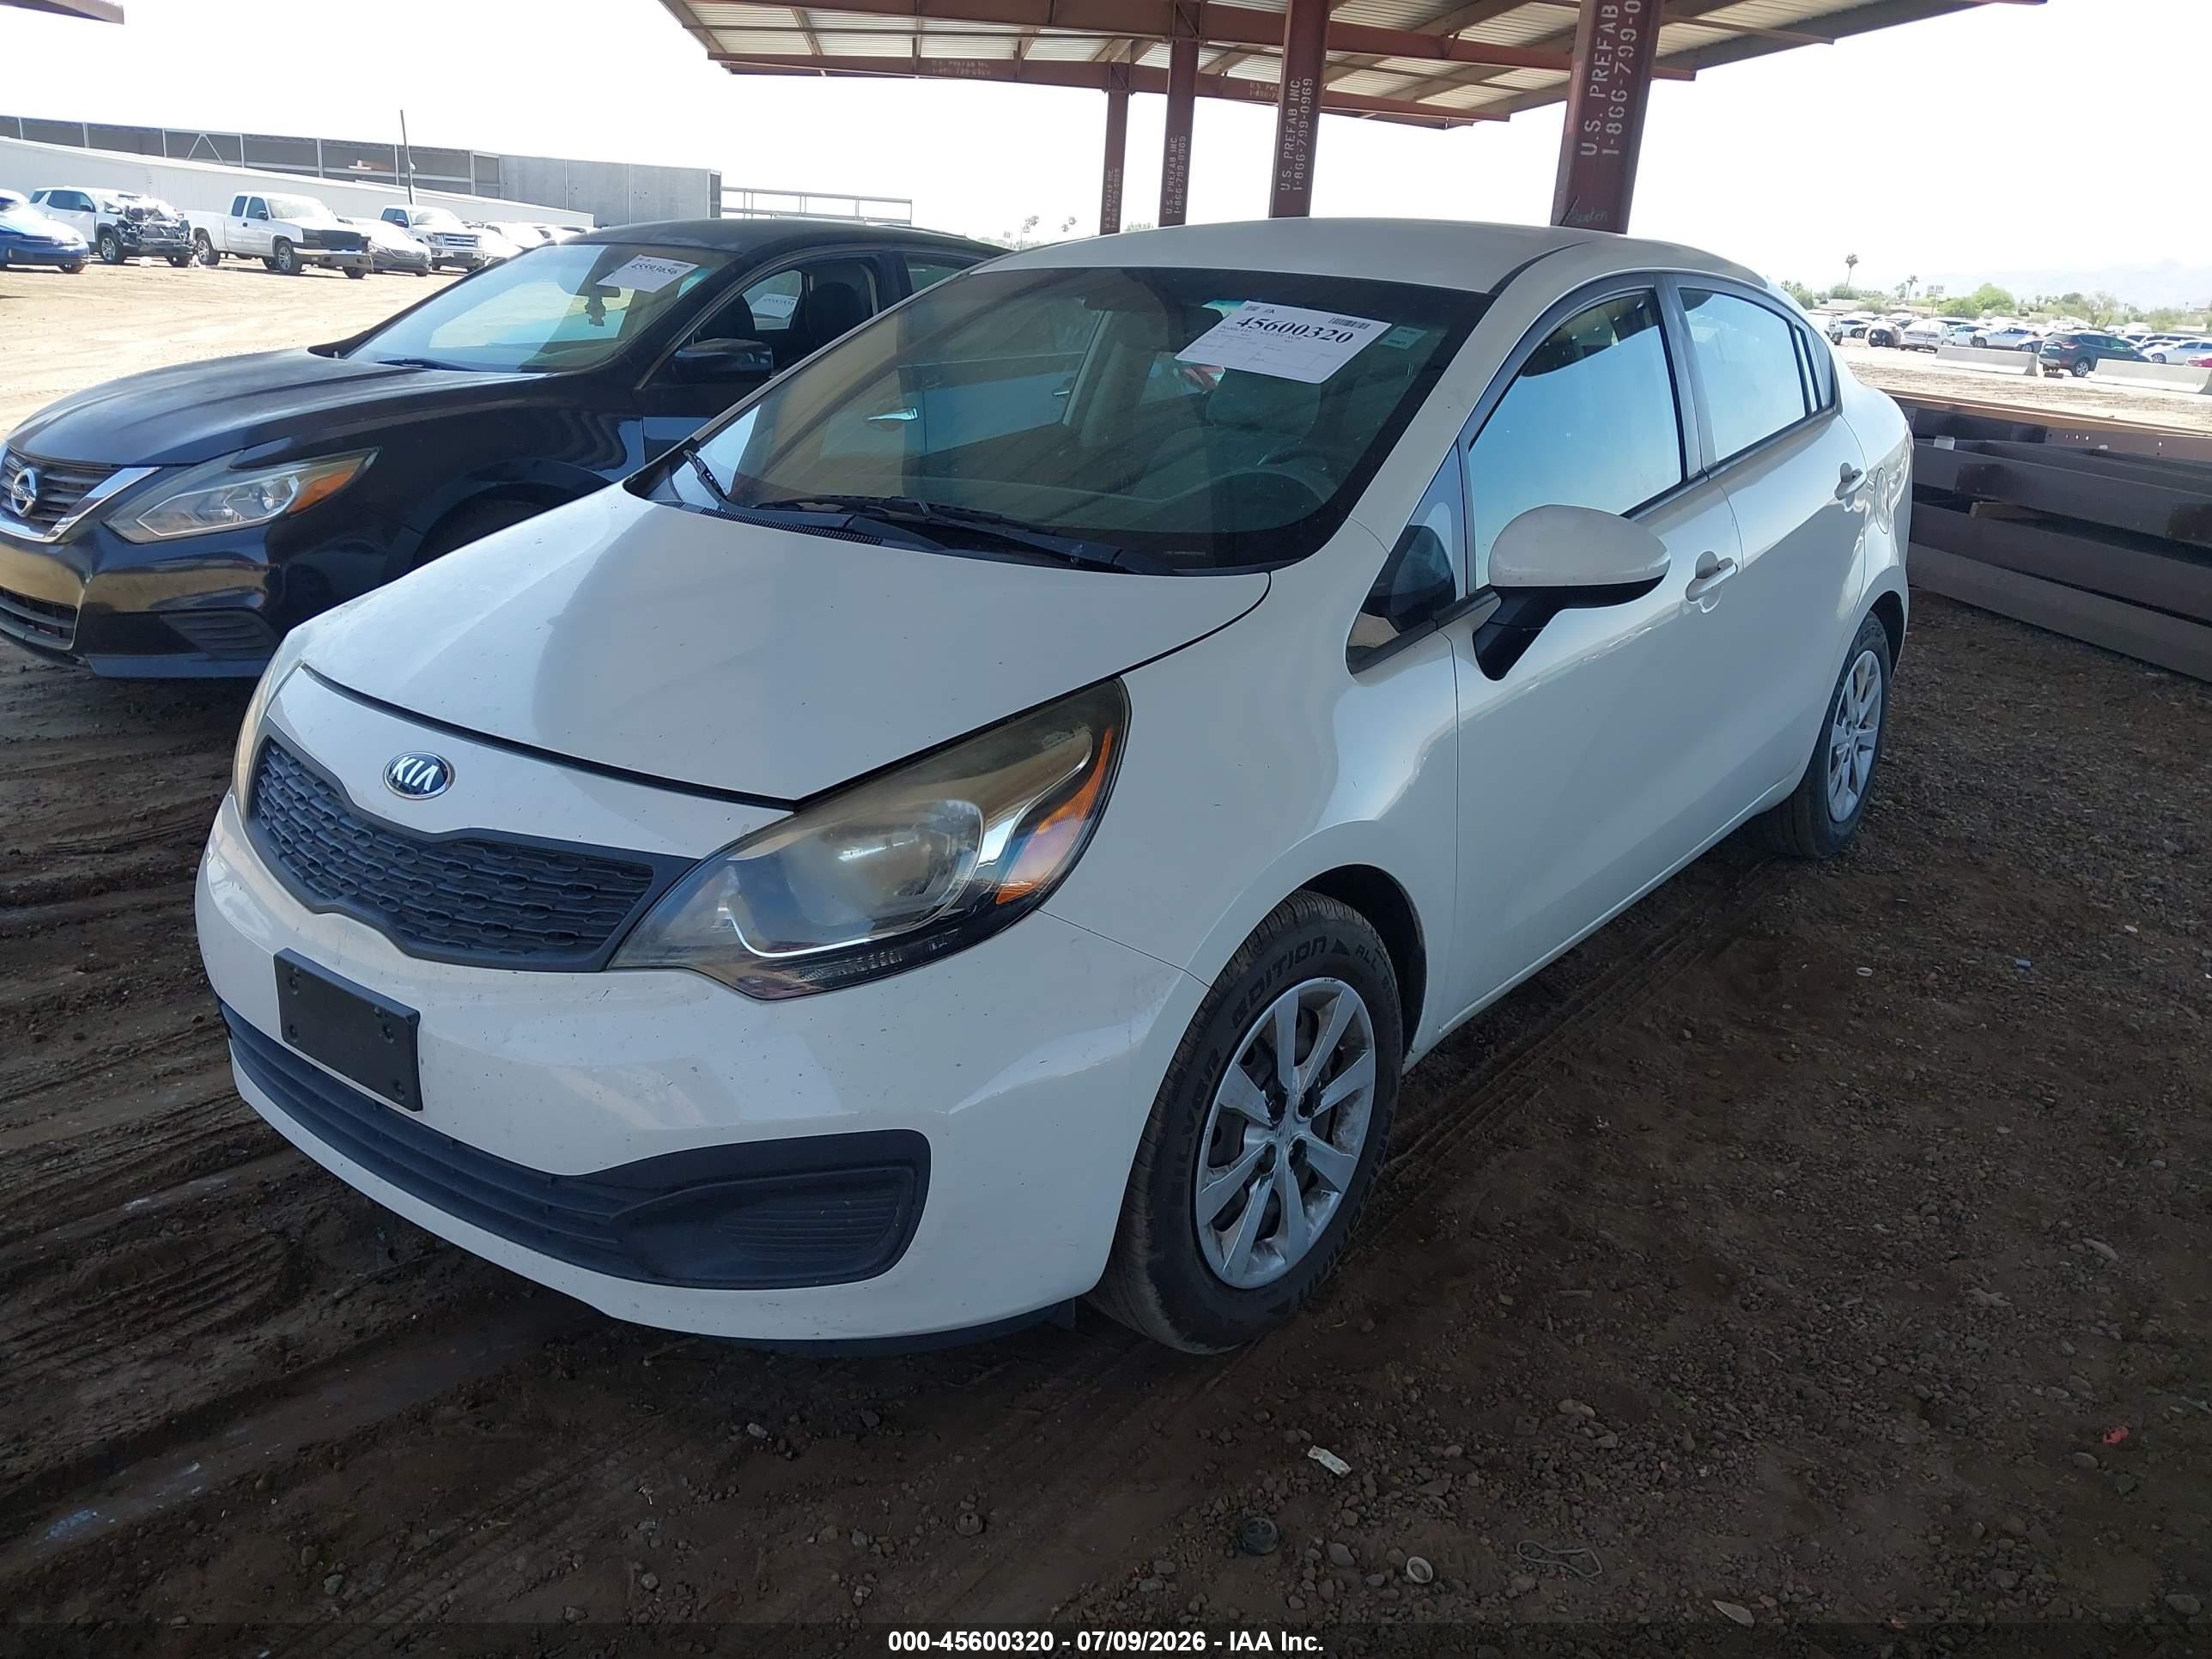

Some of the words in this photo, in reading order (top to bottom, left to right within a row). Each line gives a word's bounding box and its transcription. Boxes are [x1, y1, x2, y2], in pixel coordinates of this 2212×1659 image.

[1589, 3, 1619, 98] PREFAB
[1290, 76, 1302, 101] INC.
[1284, 108, 1297, 159] PREFAB
[1292, 78, 1313, 191] 1-866-799-0969
[1580, 112, 1604, 156] U.S.
[1279, 167, 1293, 191] U.S.
[1237, 316, 1354, 344] 45600320
[389, 756, 440, 792] KIA
[1231, 935, 1328, 1030] EDITION
